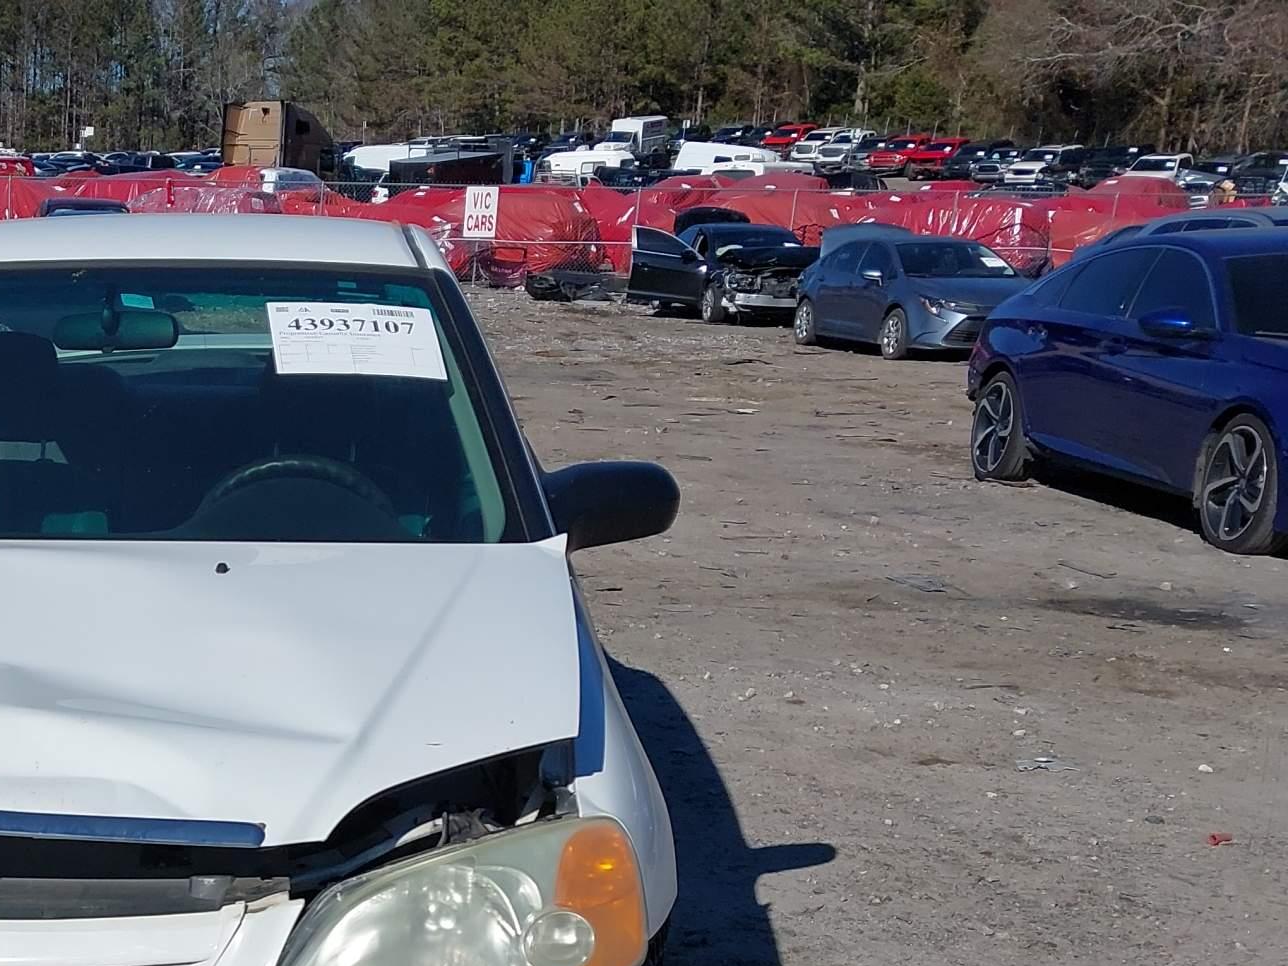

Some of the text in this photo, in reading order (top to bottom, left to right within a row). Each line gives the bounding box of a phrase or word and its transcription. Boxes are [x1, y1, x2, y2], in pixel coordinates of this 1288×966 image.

[472, 191, 492, 210] VIC
[466, 214, 495, 232] CARS
[287, 317, 415, 336] 43937107
